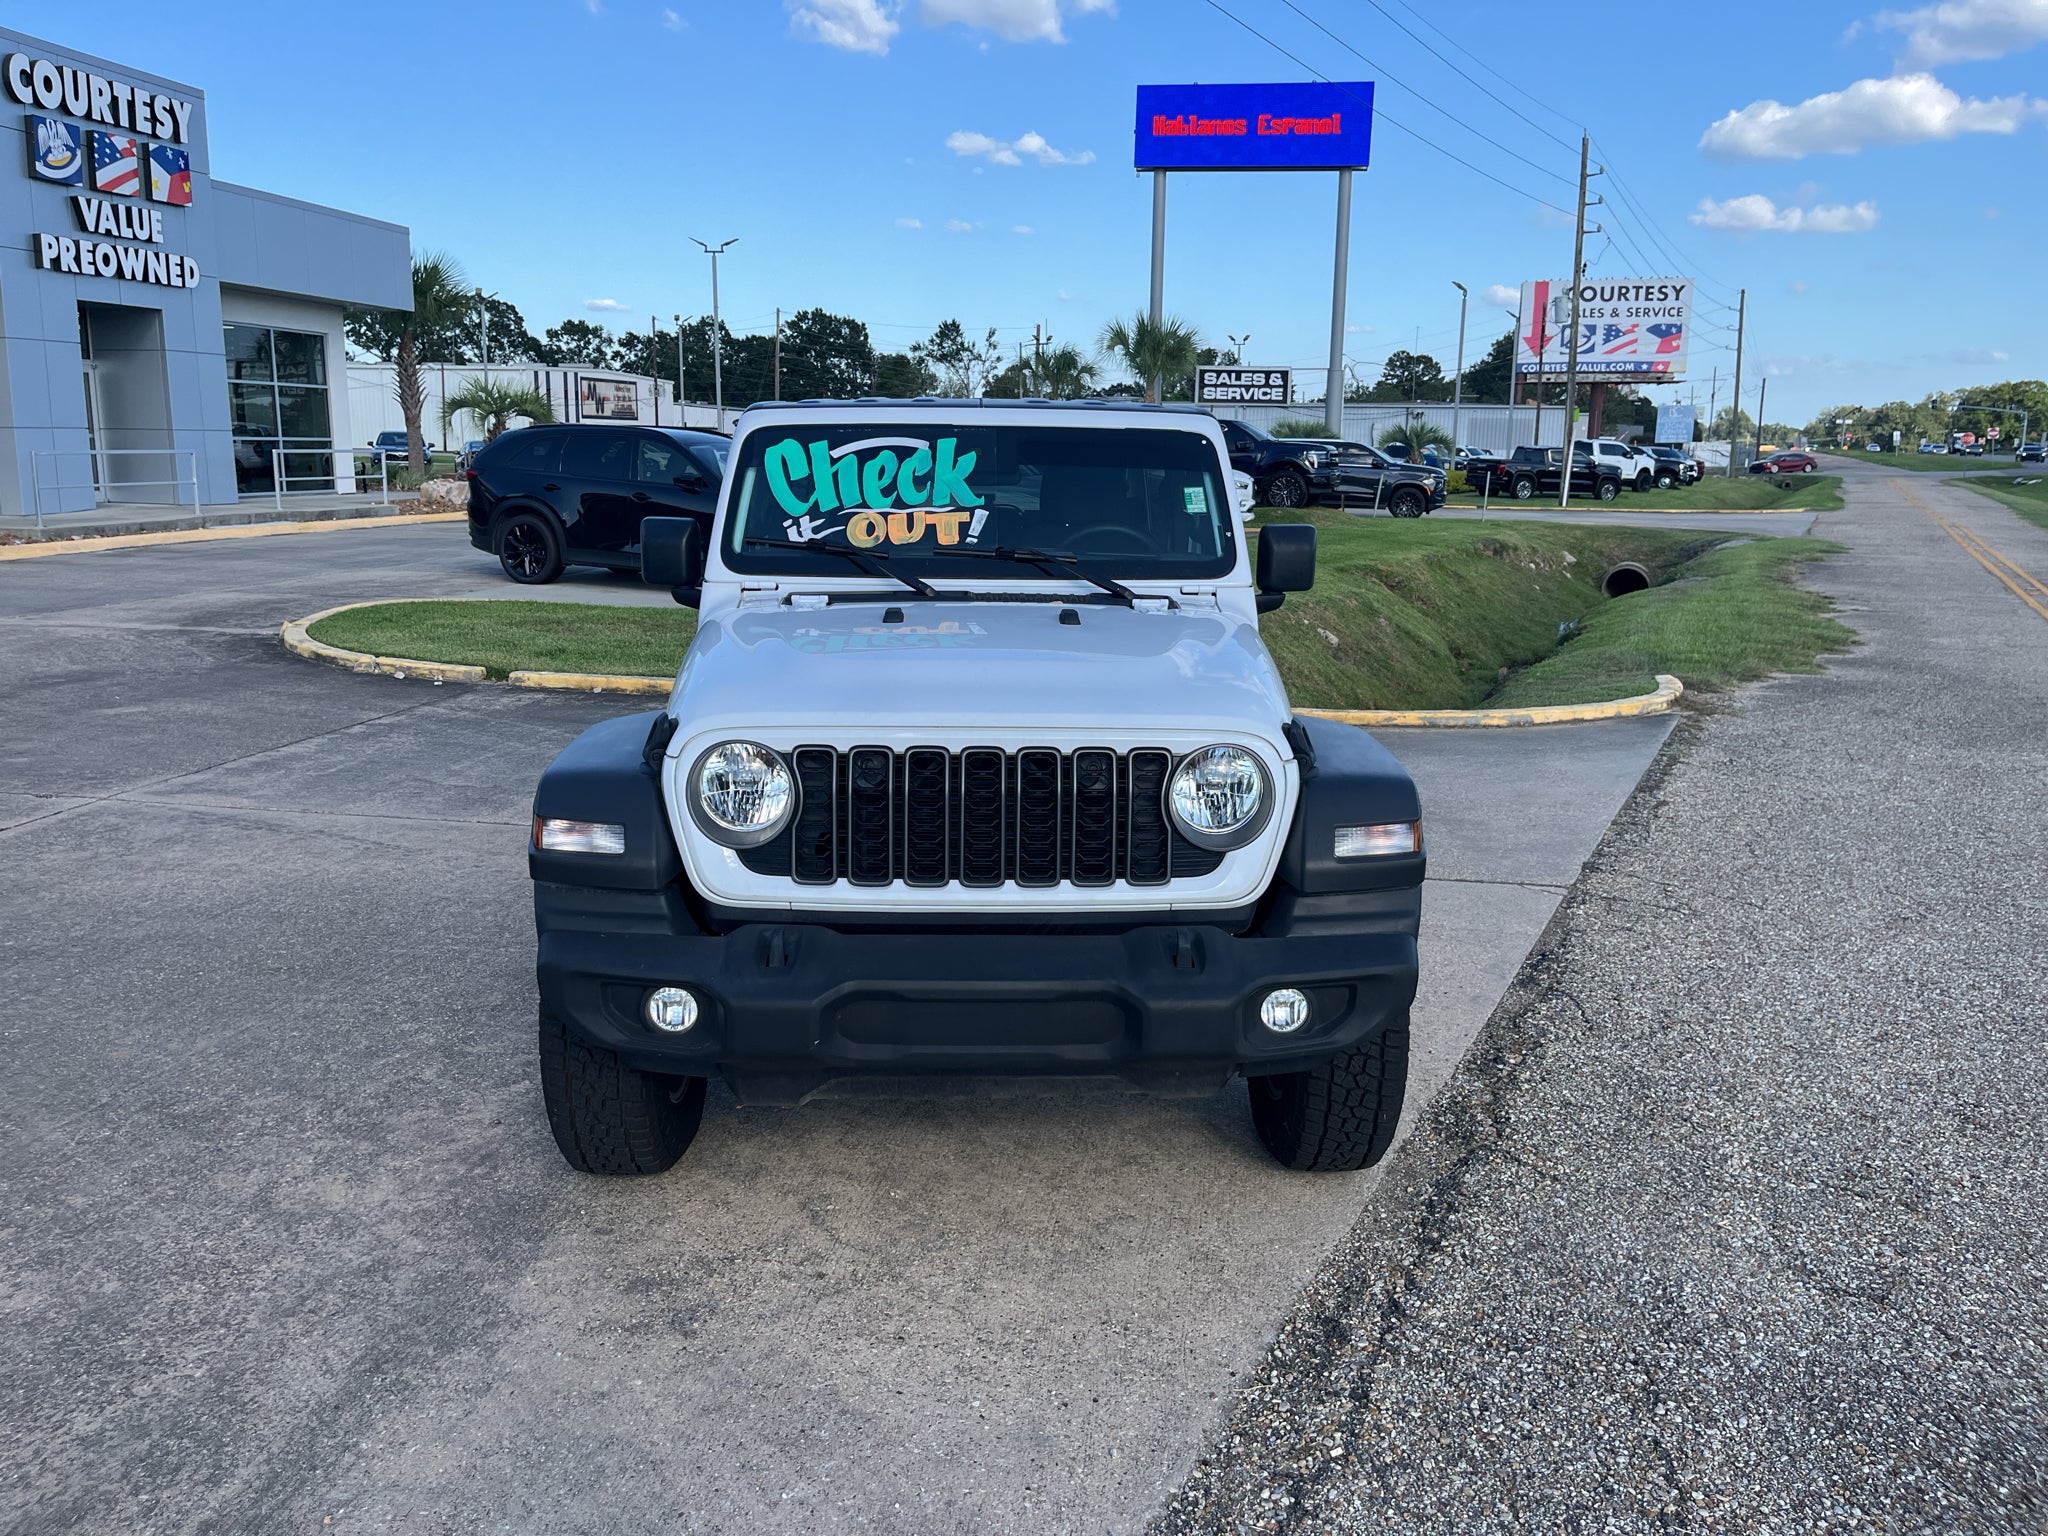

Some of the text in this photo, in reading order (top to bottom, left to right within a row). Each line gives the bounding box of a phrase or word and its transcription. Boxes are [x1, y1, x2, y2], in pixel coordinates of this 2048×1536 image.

[5, 52, 193, 144] COURTESY
[76, 195, 164, 243] VALUE
[39, 232, 200, 289] PREOWNED
[1568, 285, 1687, 302] OURTESY
[1610, 307, 1620, 318] &
[1626, 306, 1683, 318] SERVICE
[1521, 362, 1635, 373] COURTESVALUE.COM
[1203, 372, 1284, 386] SALES &
[1203, 387, 1284, 400] SERVICE
[764, 437, 985, 516] Check
[782, 515, 845, 543] it
